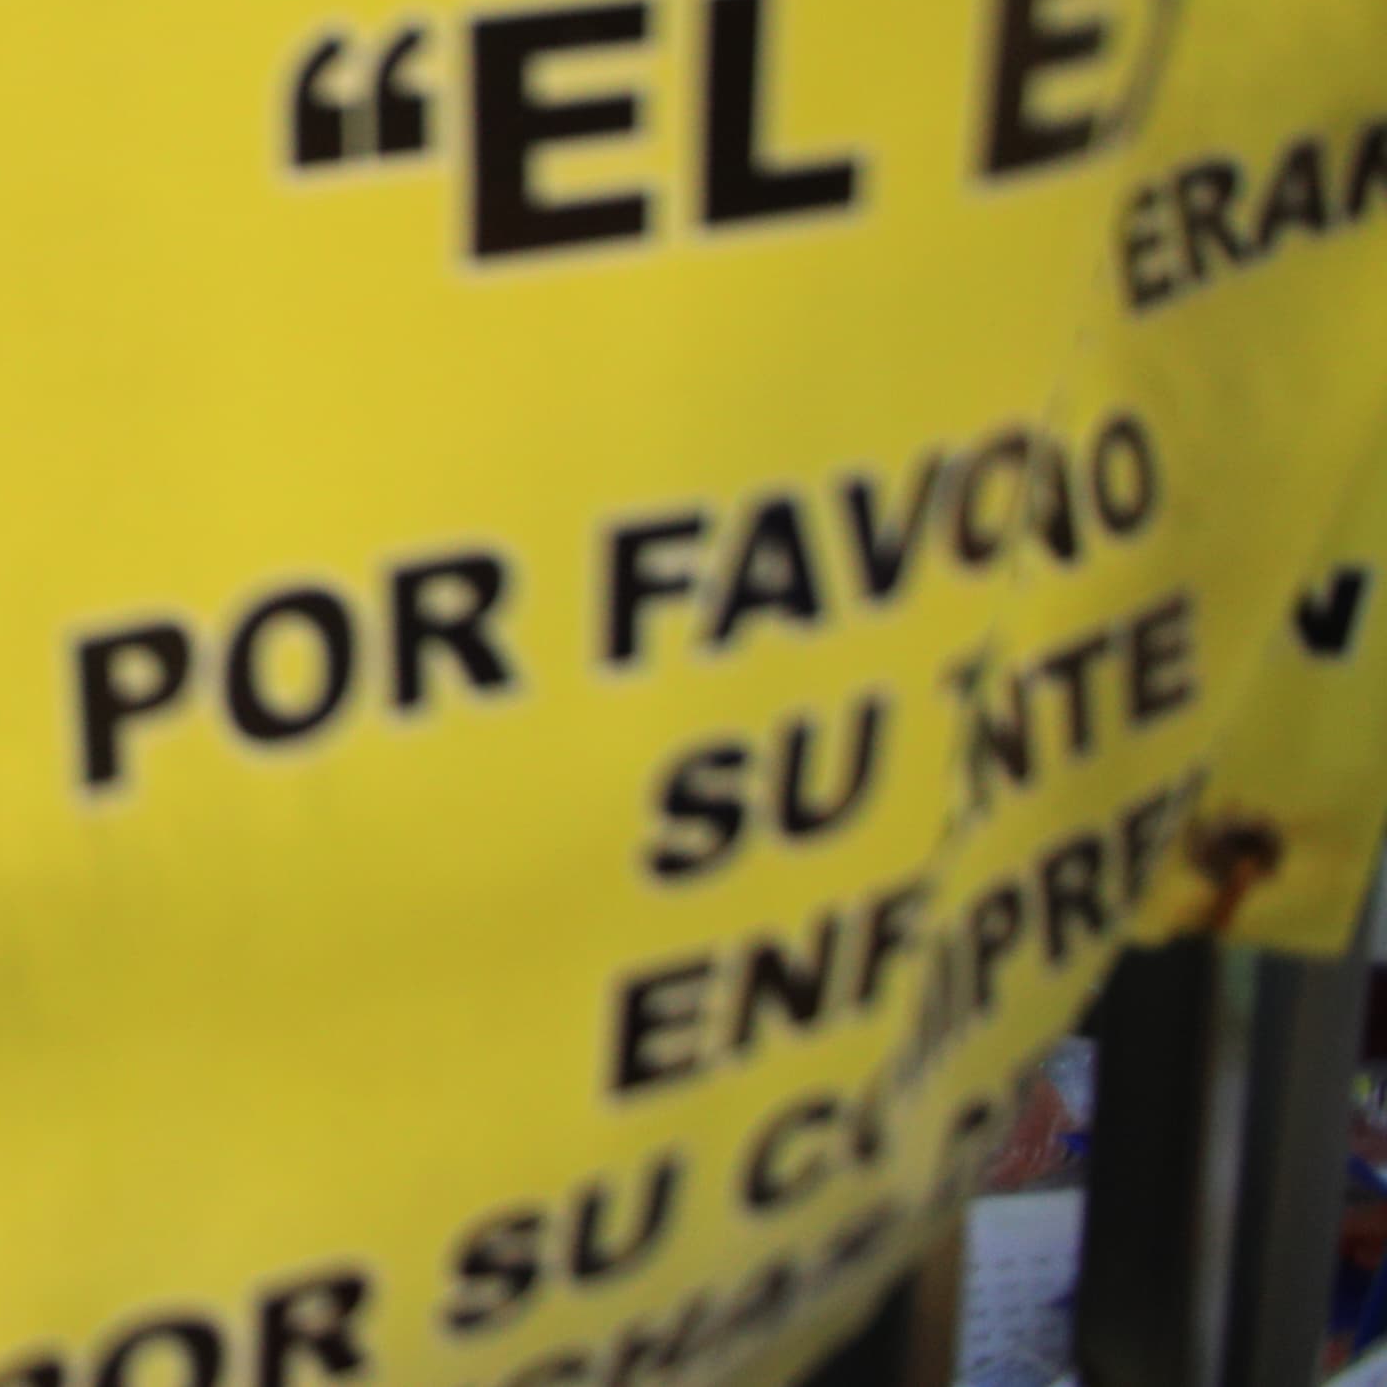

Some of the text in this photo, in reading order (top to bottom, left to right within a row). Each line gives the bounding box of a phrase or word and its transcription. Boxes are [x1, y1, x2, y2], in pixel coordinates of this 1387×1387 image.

[77, 552, 514, 791] POR
[649, 693, 883, 881] SU
[447, 1156, 681, 1330] SU
